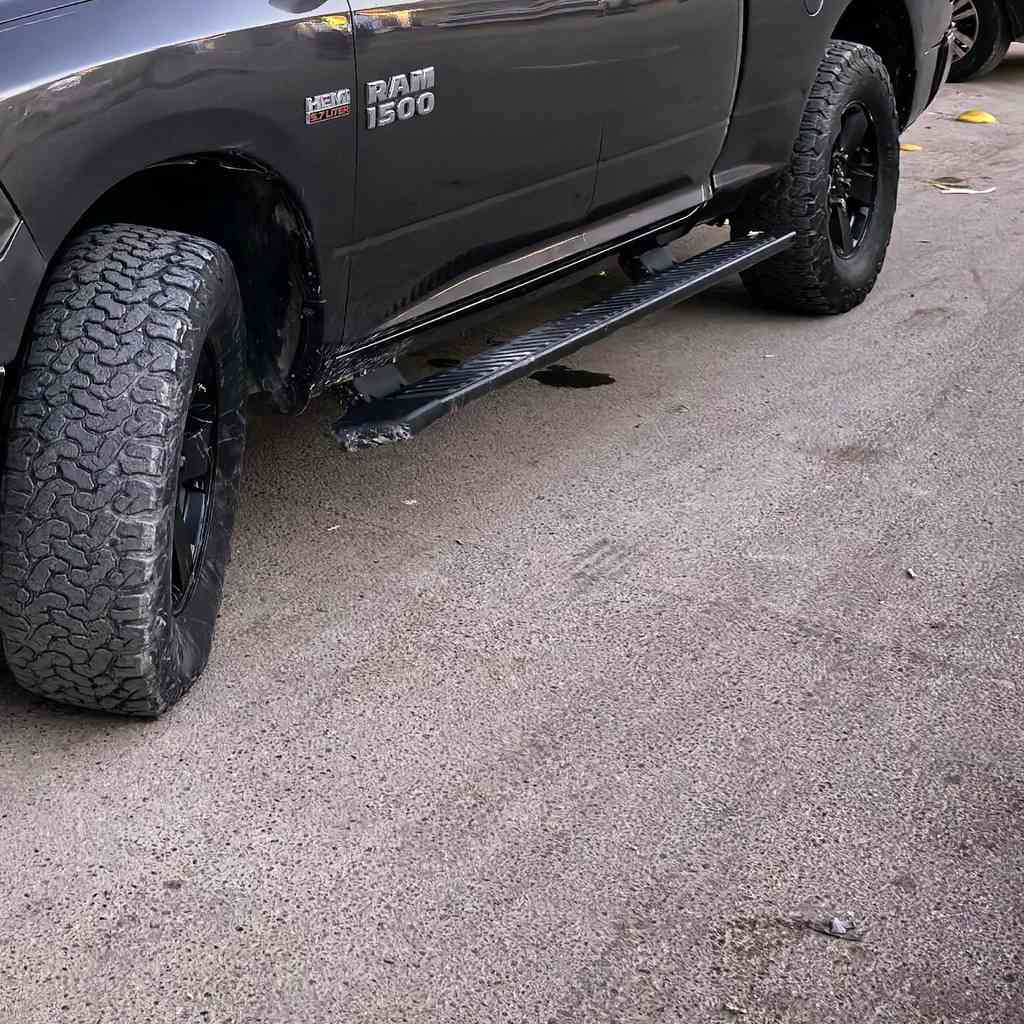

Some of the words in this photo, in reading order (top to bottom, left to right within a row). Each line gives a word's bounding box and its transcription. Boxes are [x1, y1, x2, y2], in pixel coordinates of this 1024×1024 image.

[366, 66, 436, 103] RAM
[305, 88, 351, 112] HEMI
[309, 111, 325, 122] 5.7
[326, 105, 351, 120] LITER
[366, 91, 436, 130] 1500
